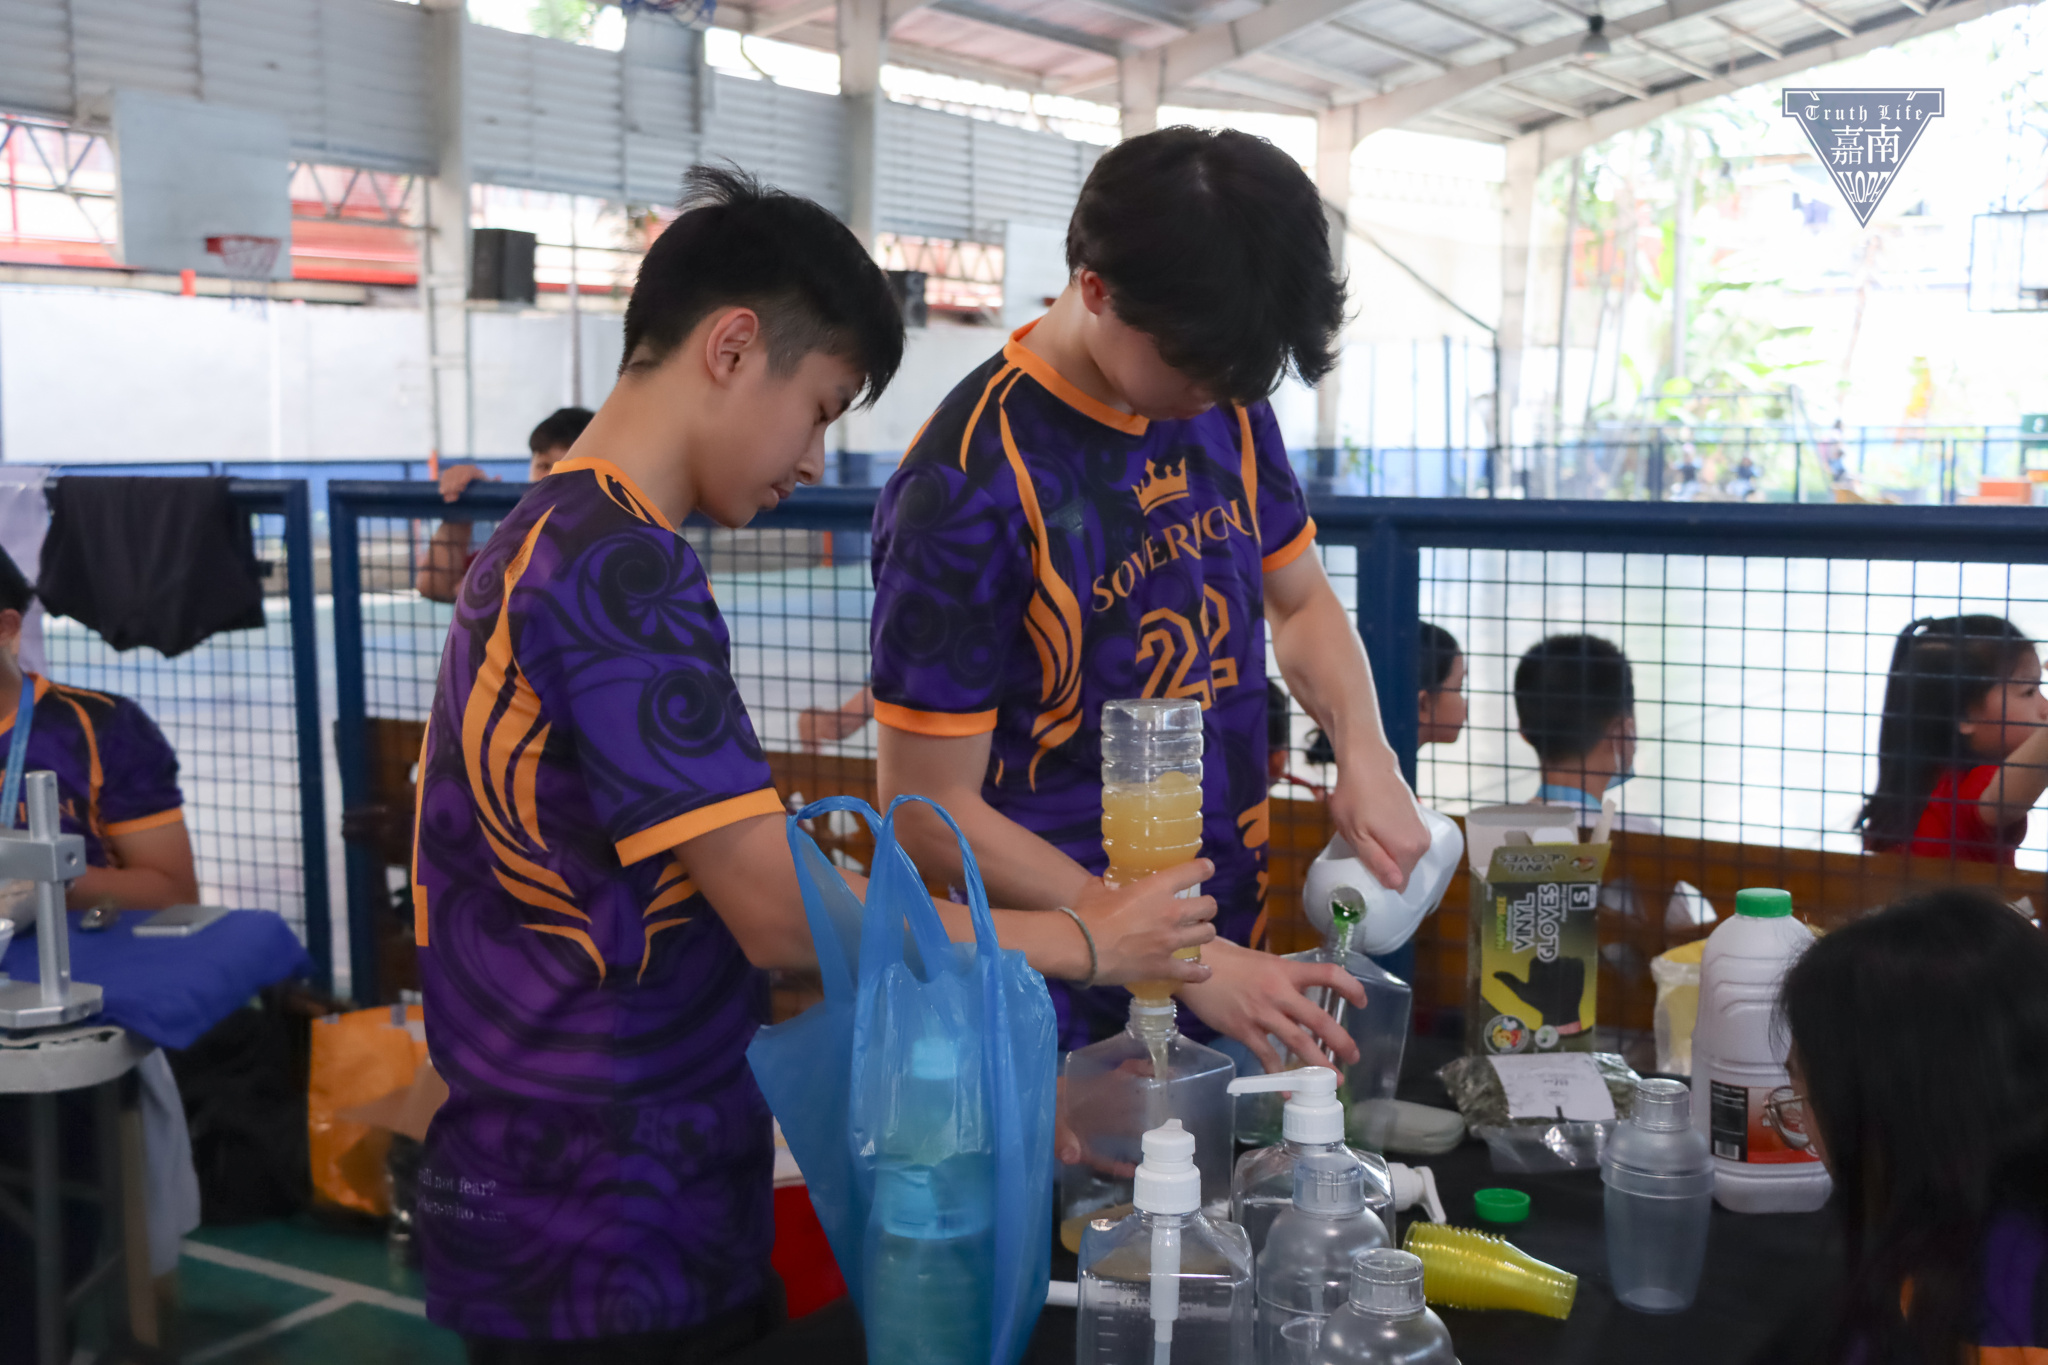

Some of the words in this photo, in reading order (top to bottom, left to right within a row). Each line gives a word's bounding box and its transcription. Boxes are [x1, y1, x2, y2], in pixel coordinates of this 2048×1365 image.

[1135, 583, 1239, 711] 22
[1512, 892, 1536, 954] VINYL
[1536, 882, 1560, 963] GLOVES
[1572, 890, 1590, 903] S
[434, 1174, 455, 1192] not
[458, 1175, 497, 1197] fear?
